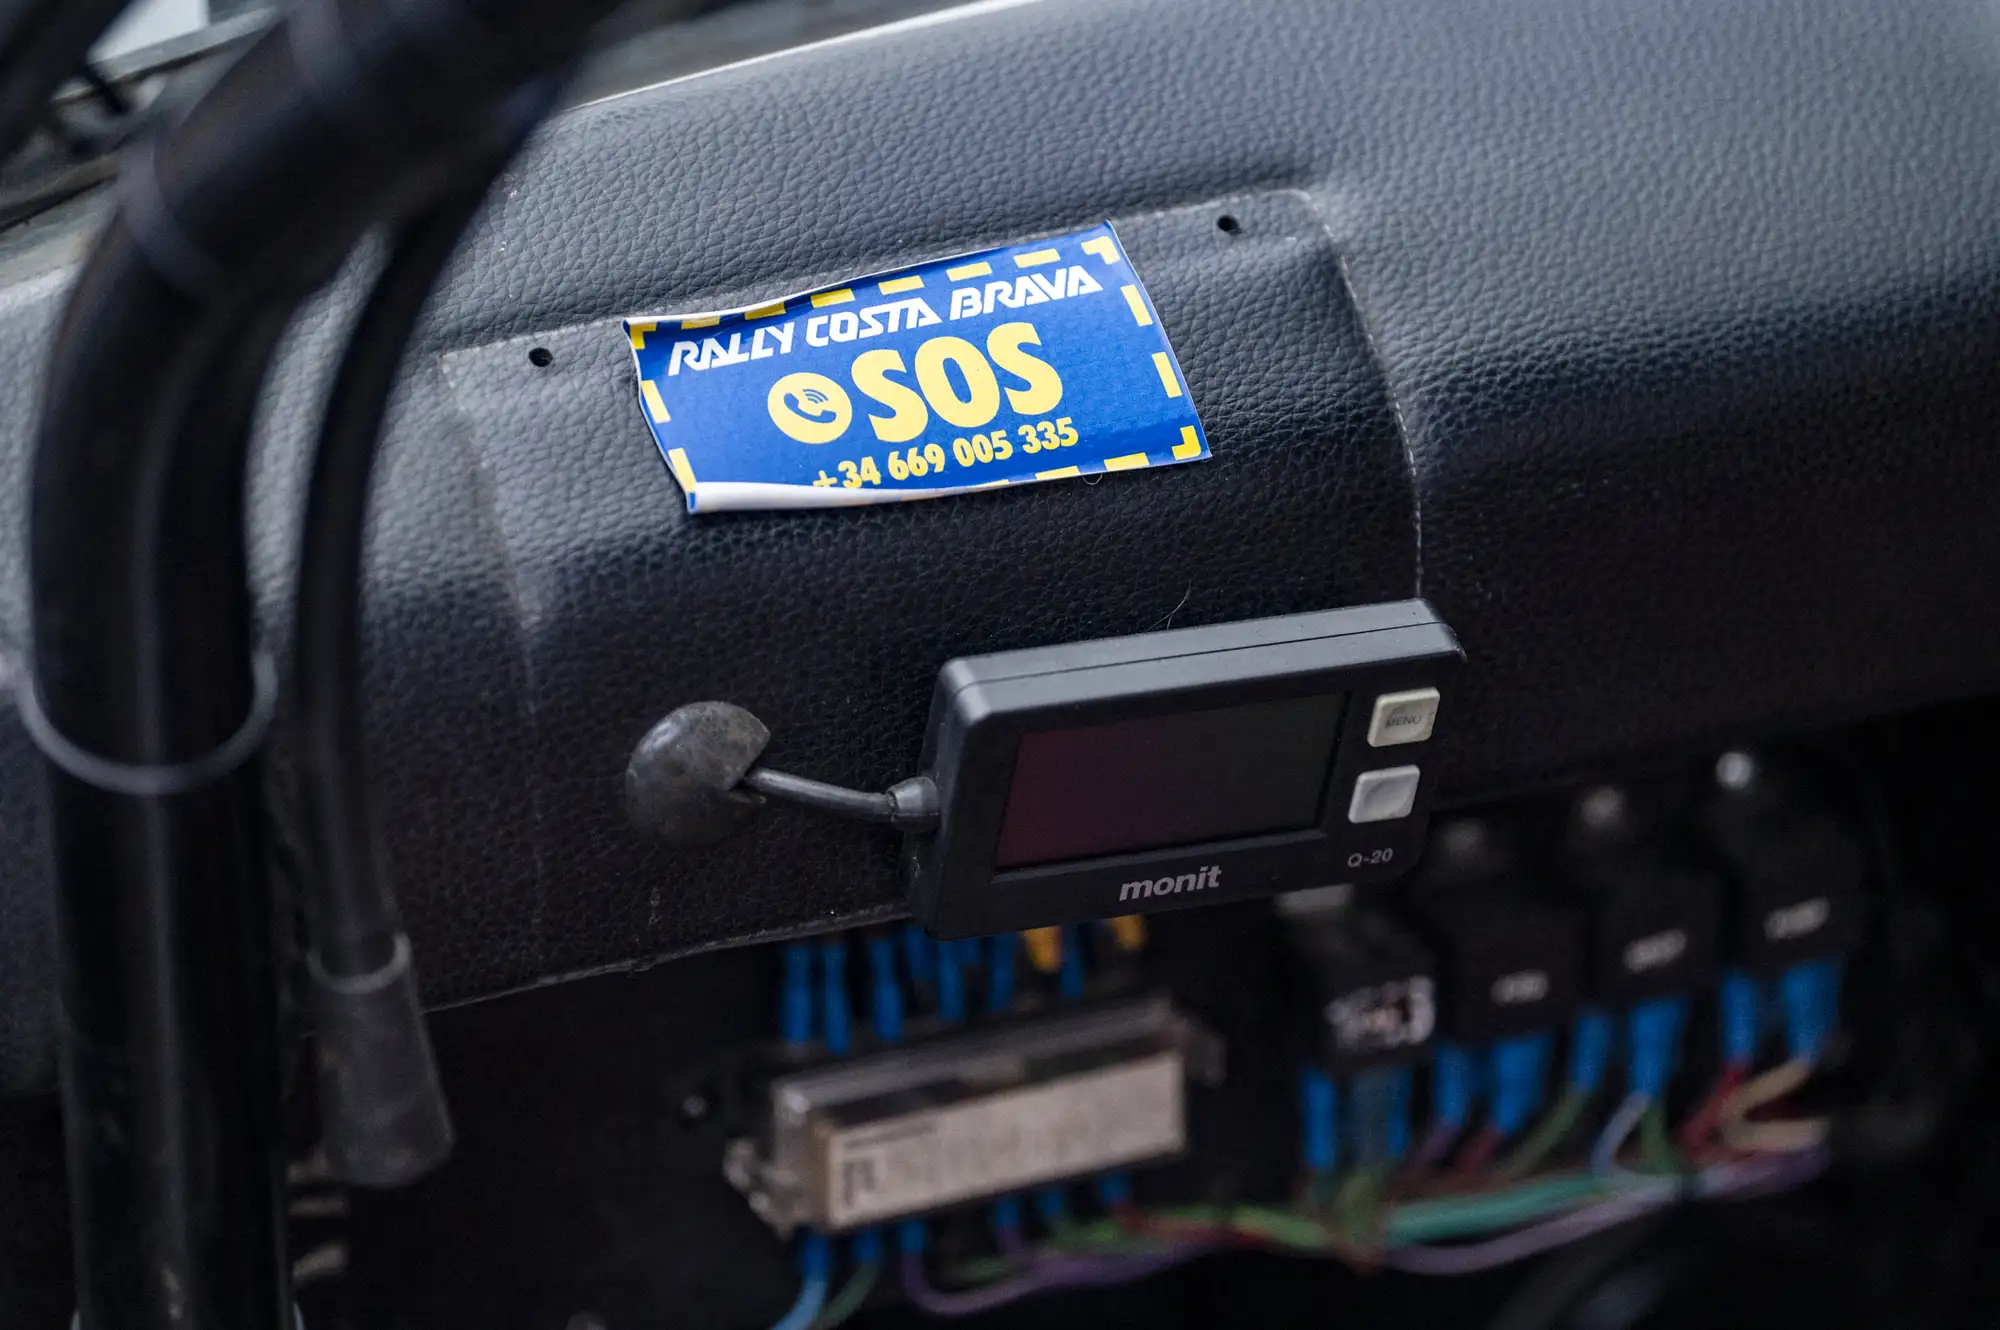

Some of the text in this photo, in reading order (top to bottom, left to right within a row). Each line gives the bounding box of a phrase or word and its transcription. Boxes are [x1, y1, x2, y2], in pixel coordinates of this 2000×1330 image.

[668, 265, 1103, 376] RALLY COSTA BRAVA
[850, 322, 1064, 443] SOS
[812, 416, 1080, 489] +34 669 005 335
[1384, 714, 1423, 729] MENU
[1118, 865, 1222, 902] monit
[1347, 847, 1394, 868] Q-20
